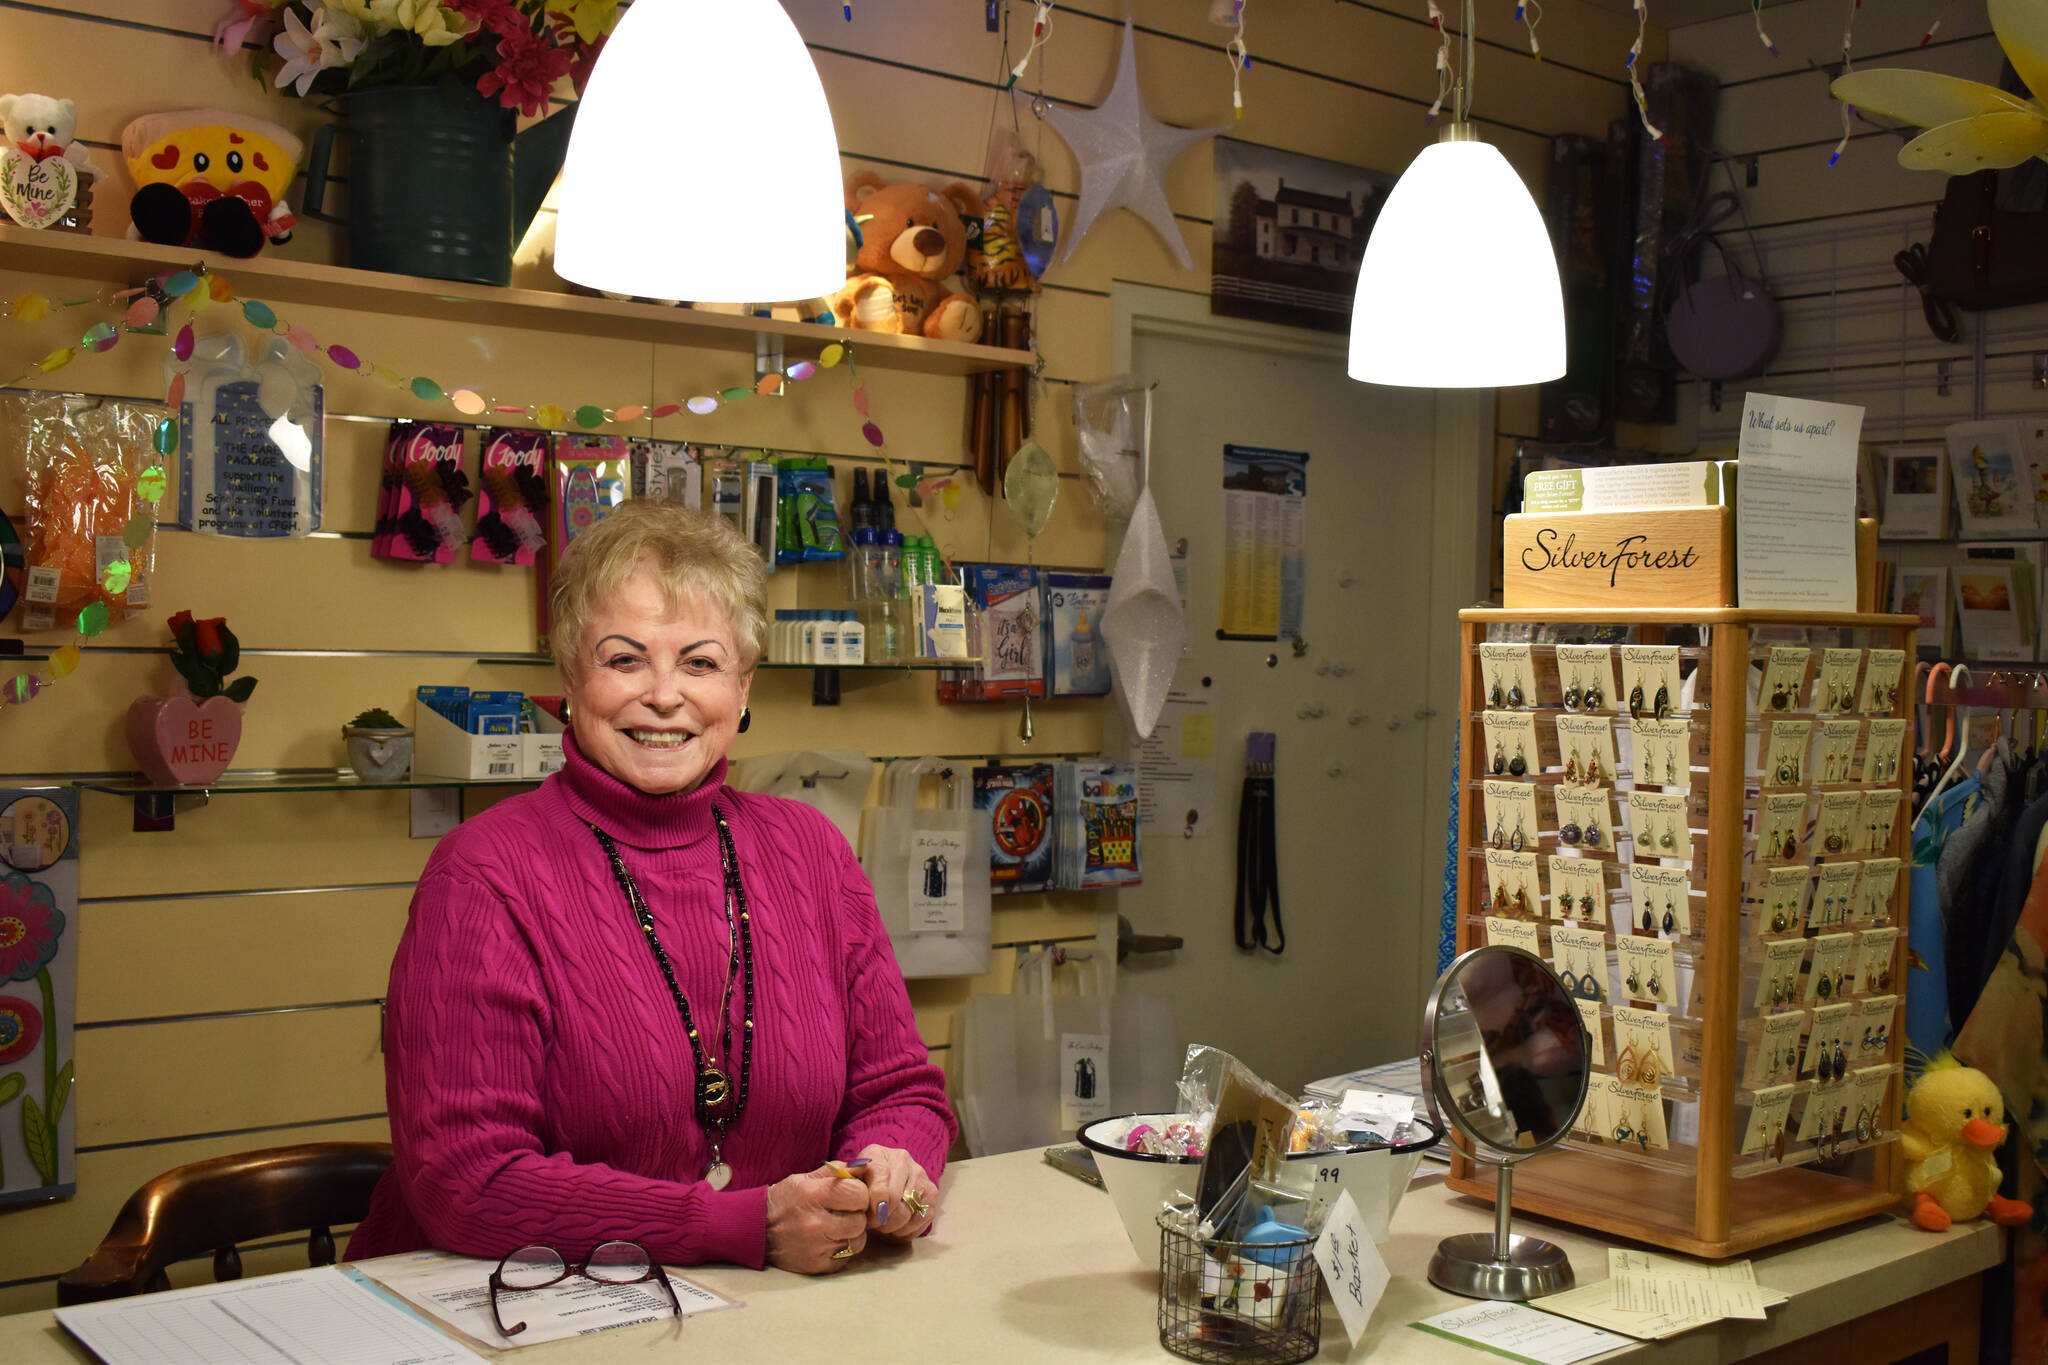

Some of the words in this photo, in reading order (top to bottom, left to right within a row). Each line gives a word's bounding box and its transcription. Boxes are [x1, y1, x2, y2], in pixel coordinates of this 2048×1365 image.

[29, 165, 49, 183] Be
[17, 183, 55, 201] Mine
[1748, 410, 1774, 430] What
[1774, 417, 1792, 432] sets
[1793, 424, 1804, 434] us
[1805, 419, 1836, 439] apart?
[224, 442, 247, 453] THE
[409, 426, 460, 473] Goody
[487, 432, 543, 478] Goody
[226, 456, 277, 467] PACKAGE
[223, 471, 262, 483] support
[268, 472, 284, 482] the
[1534, 480, 1555, 491] FREE
[1555, 478, 1577, 490] GIFT
[272, 496, 296, 506] Fund
[202, 506, 221, 516] and
[227, 506, 243, 516] the
[249, 508, 299, 518] Volunteer
[199, 519, 247, 529] programs
[996, 638, 1026, 669] Girl
[188, 719, 213, 740] BE
[171, 742, 229, 764] MINE
[1082, 779, 1135, 797] balloon
[1345, 1223, 1364, 1308] Basket
